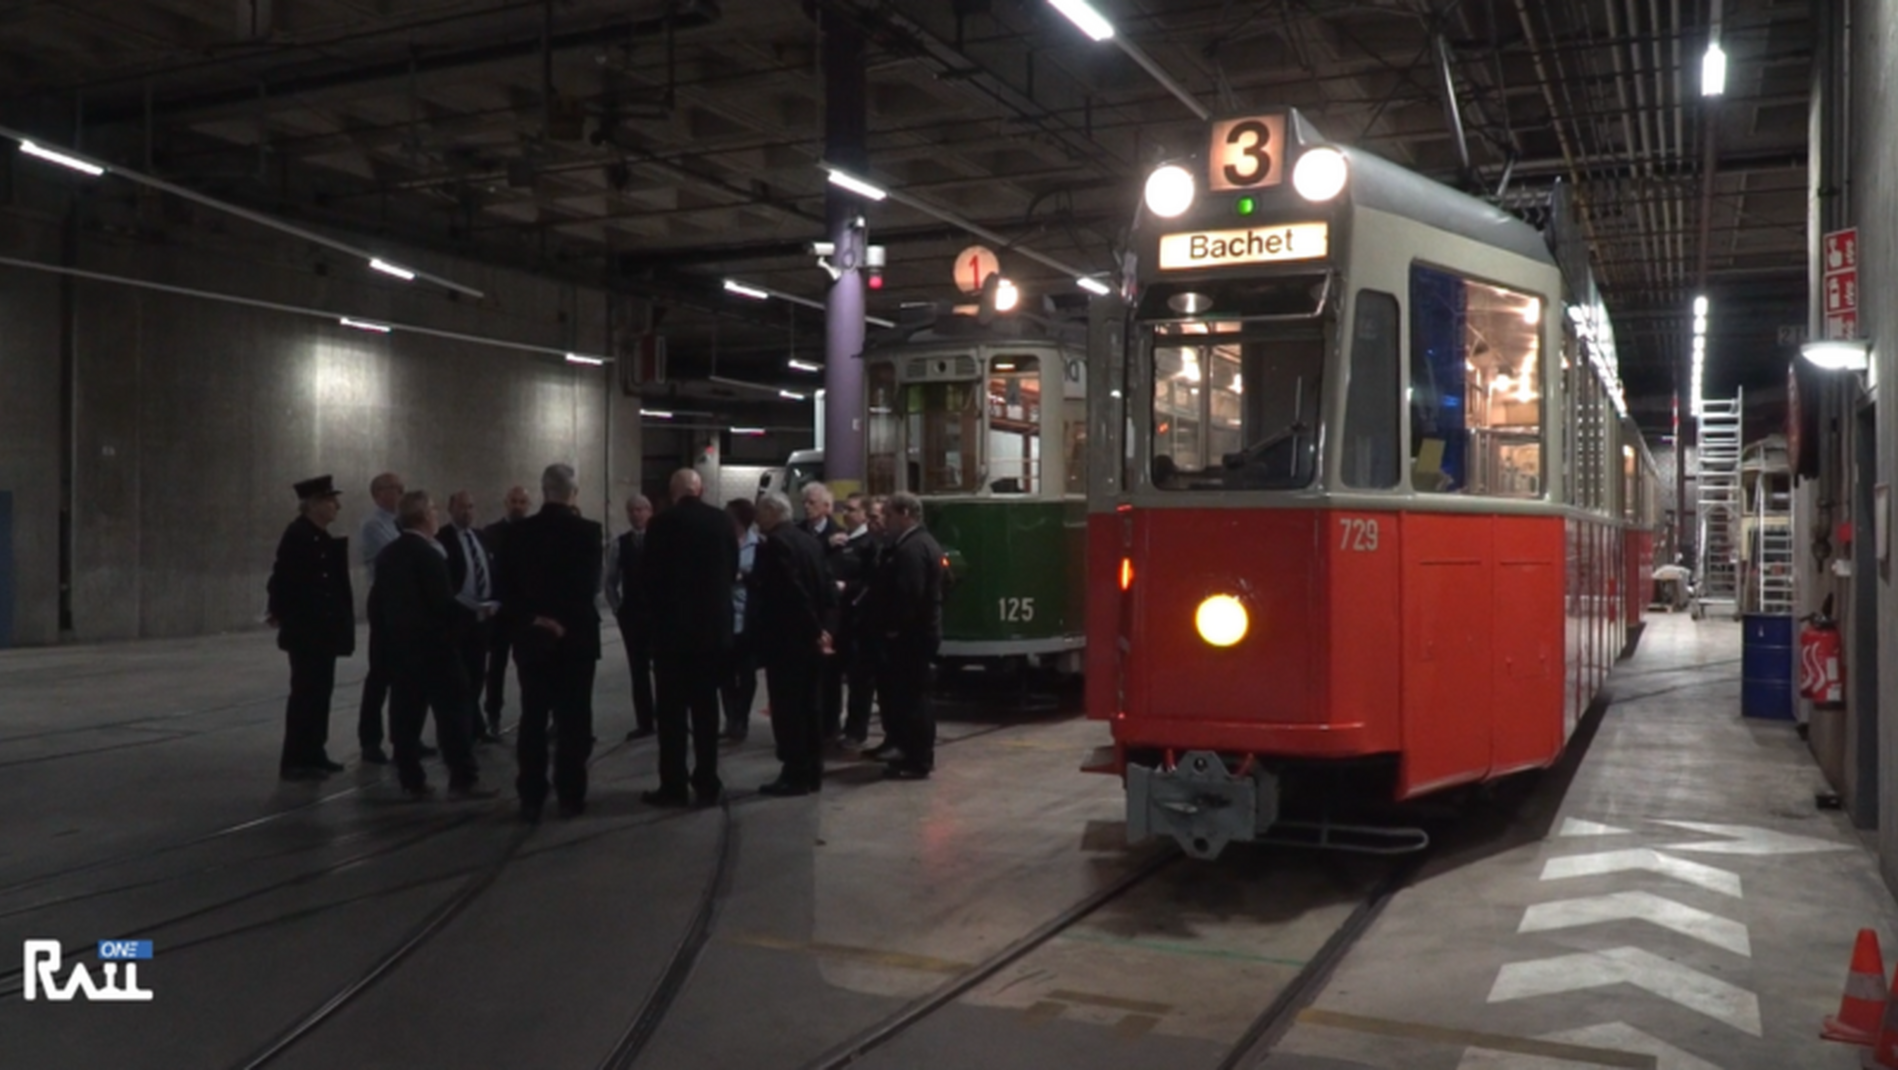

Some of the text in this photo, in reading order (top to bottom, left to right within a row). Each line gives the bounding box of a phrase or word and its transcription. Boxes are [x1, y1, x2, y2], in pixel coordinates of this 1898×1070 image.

[1223, 120, 1272, 187] 3
[1189, 229, 1294, 260] Bachet
[968, 254, 981, 290] 1
[1339, 518, 1379, 551] 729
[998, 597, 1035, 622] 125
